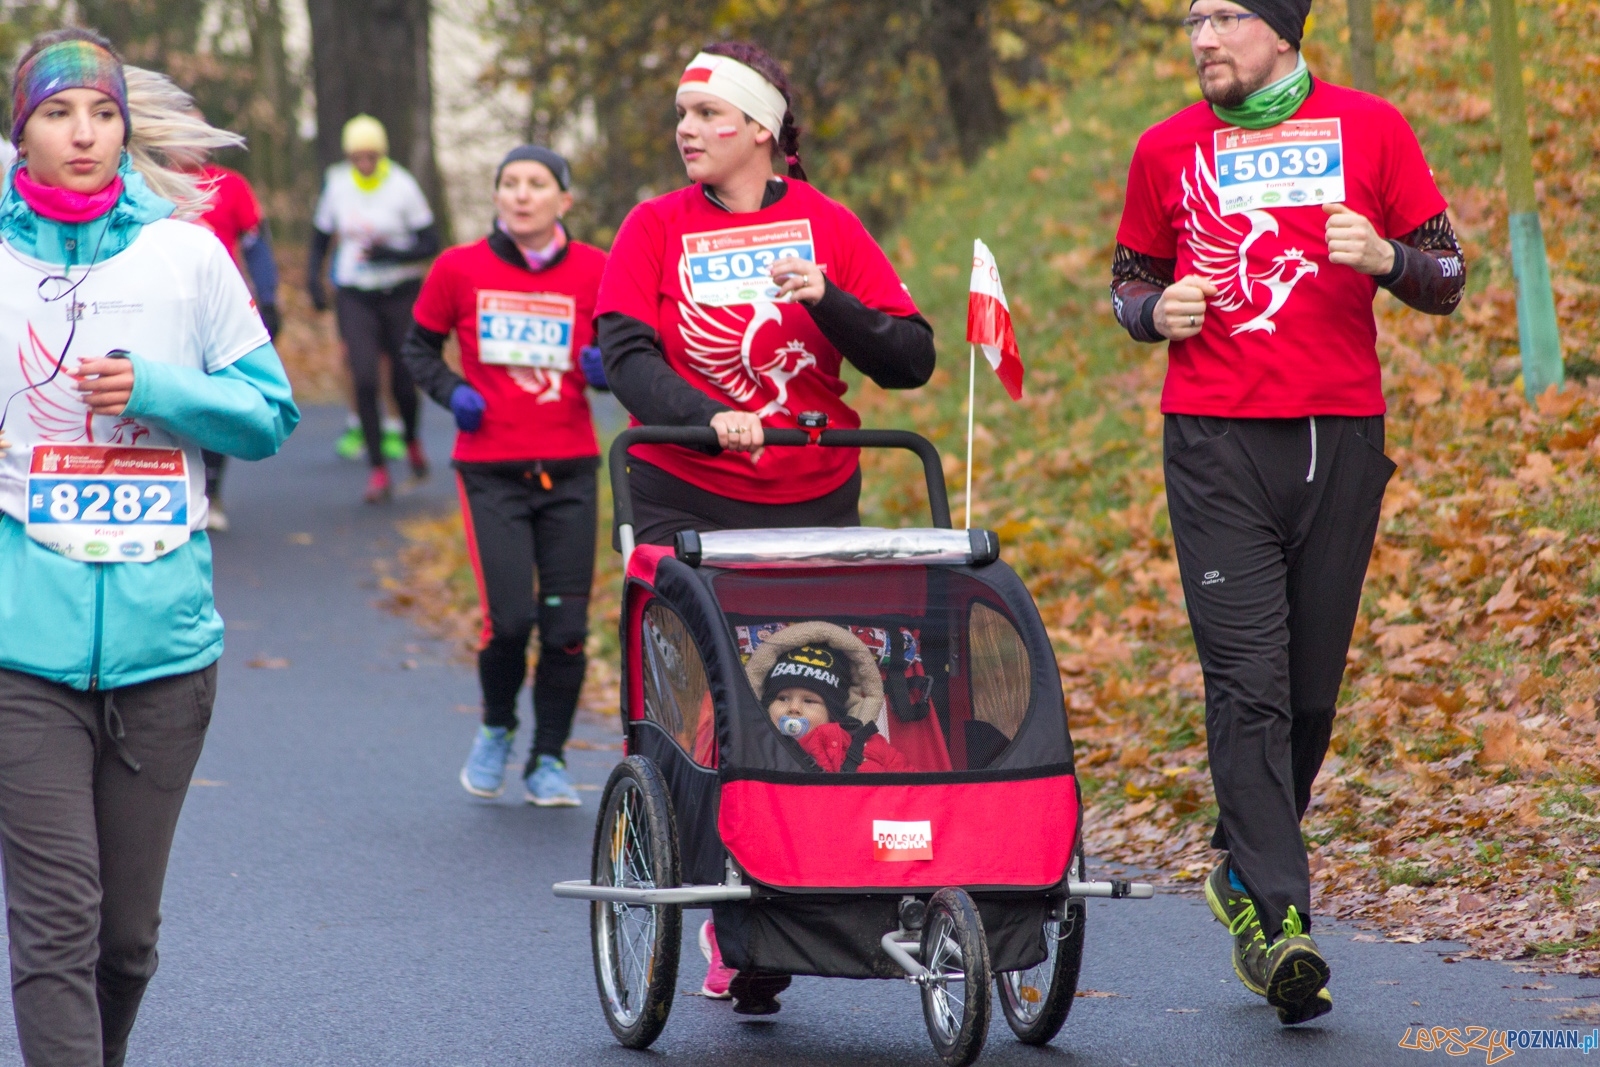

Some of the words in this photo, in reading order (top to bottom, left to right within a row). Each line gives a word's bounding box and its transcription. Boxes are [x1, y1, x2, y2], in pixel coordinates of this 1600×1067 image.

[1281, 129, 1331, 137] RunPoland.org
[1220, 165, 1229, 176] E
[1234, 147, 1328, 181] 5039
[490, 317, 563, 345] 6730
[114, 459, 176, 471] RunPoland.org
[32, 494, 44, 508] E
[50, 483, 173, 522] 8282
[94, 528, 125, 537] Kinga
[770, 661, 840, 688] BATMAN
[878, 832, 928, 850] POLSKA
